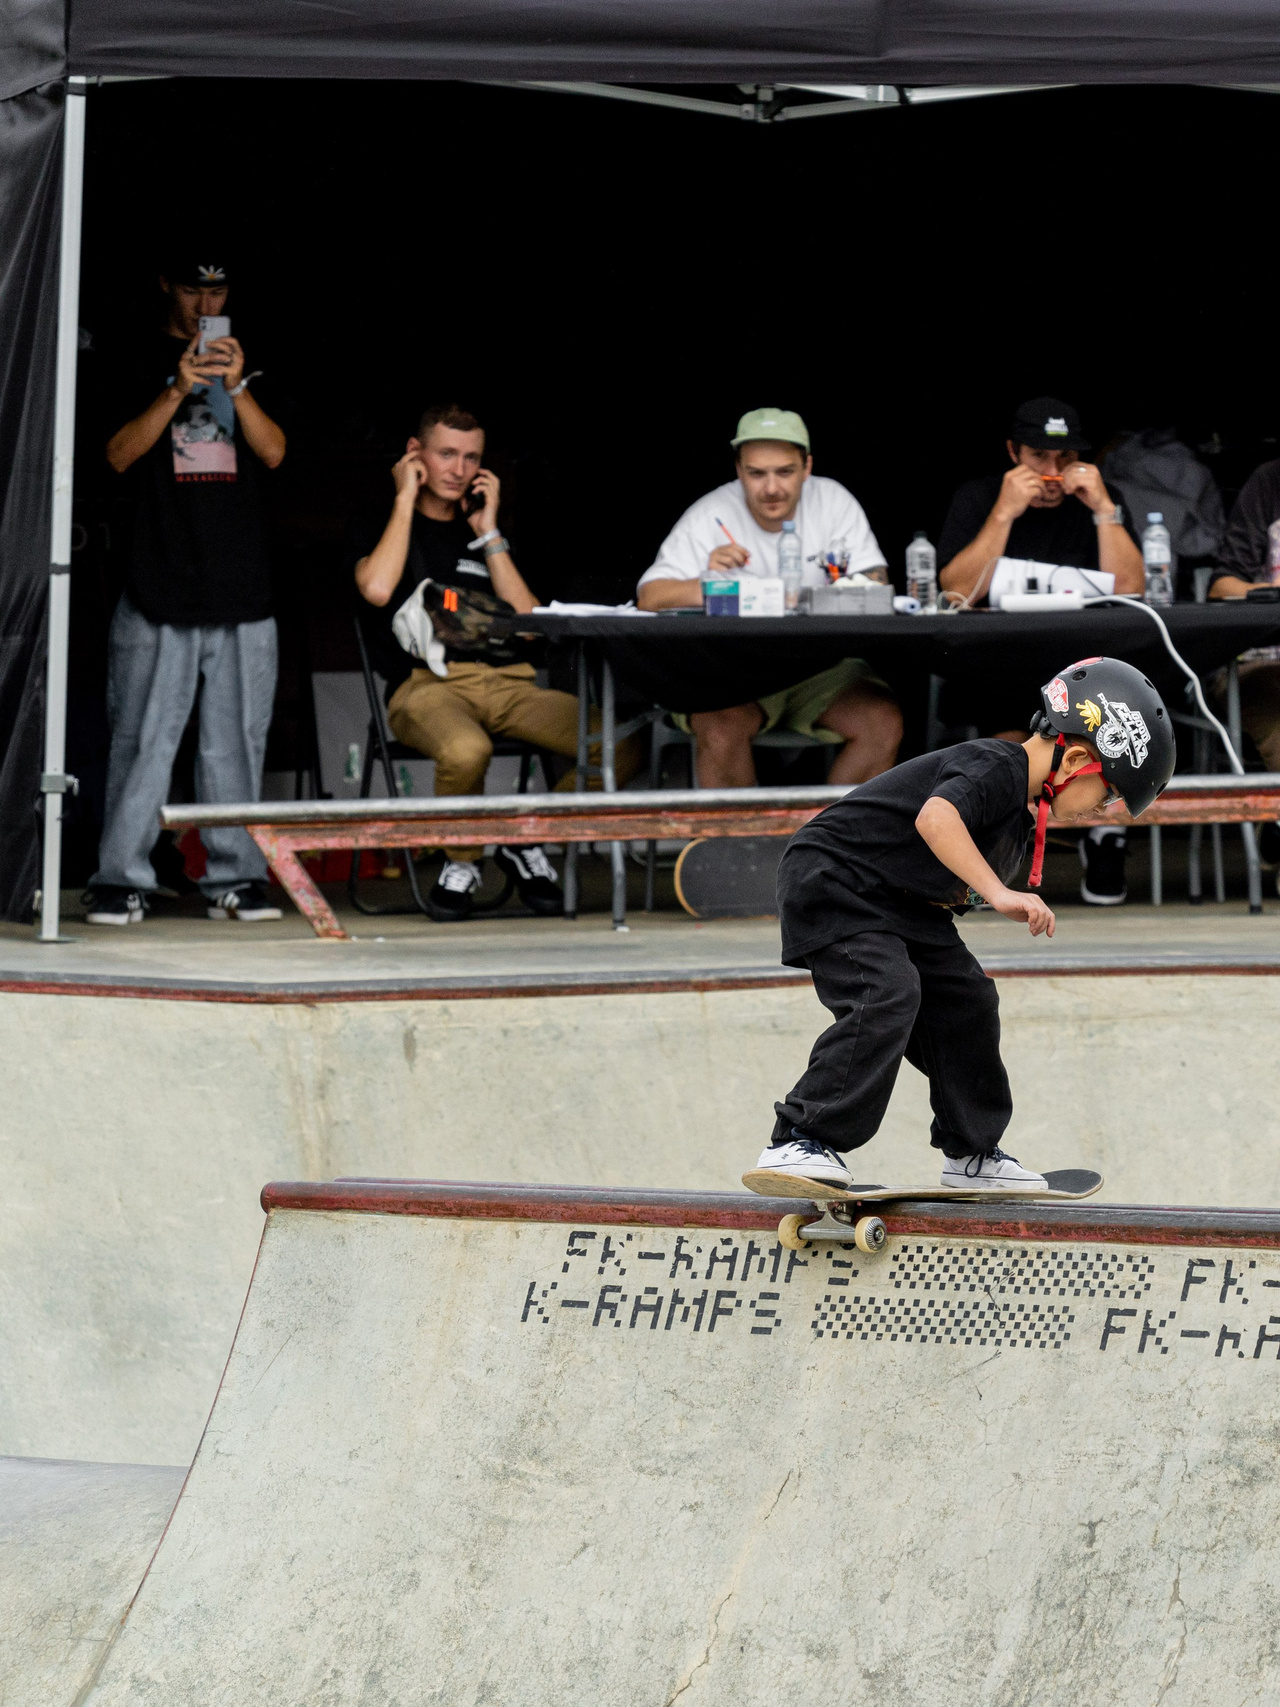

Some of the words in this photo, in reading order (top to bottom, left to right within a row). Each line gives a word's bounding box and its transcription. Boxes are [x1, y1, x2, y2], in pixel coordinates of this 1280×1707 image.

[1131, 713, 1149, 743] GOOD
[562, 1230, 859, 1287] FK-RAMPS
[520, 1281, 783, 1335] K-RAMPS
